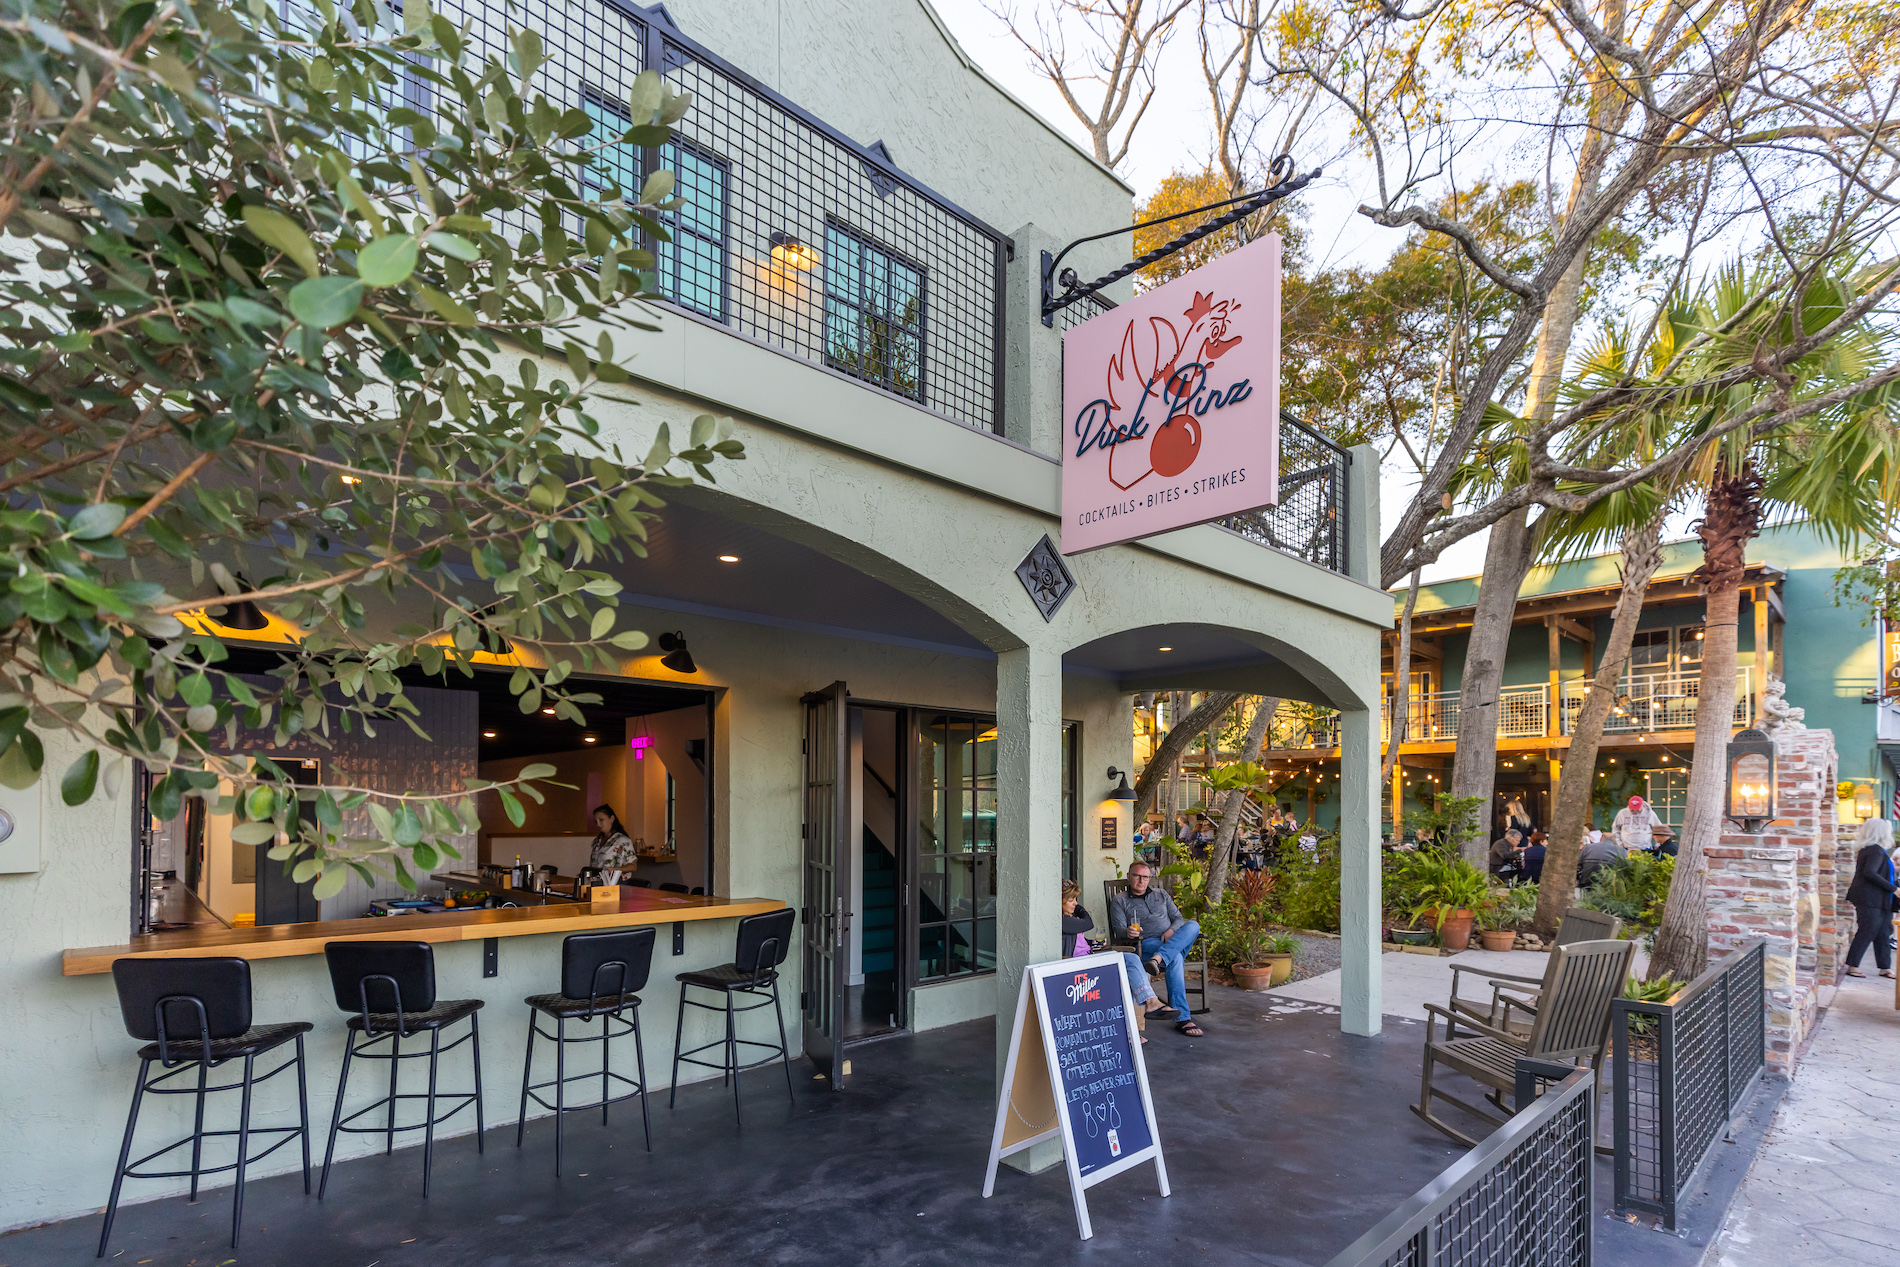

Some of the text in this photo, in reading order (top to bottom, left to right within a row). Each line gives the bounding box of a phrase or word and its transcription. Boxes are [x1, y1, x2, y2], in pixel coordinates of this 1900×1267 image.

[1075, 362, 1253, 458] Duck Pinz
[1078, 467, 1247, 526] COCKTAILS BITES STRIKES
[1065, 975, 1100, 1006] Miller
[1074, 972, 1089, 986] IT'S
[1083, 988, 1102, 1003] TIME
[1053, 1005, 1125, 1032] WHAT DID ONE
[1054, 1023, 1118, 1052] ROMANTIC PIN
[1060, 1041, 1115, 1069] SAY TO THE
[1066, 1051, 1122, 1081] OTHER PIN?
[1088, 1076, 1117, 1095] NEVER
[1114, 1071, 1136, 1087] SPLIT
